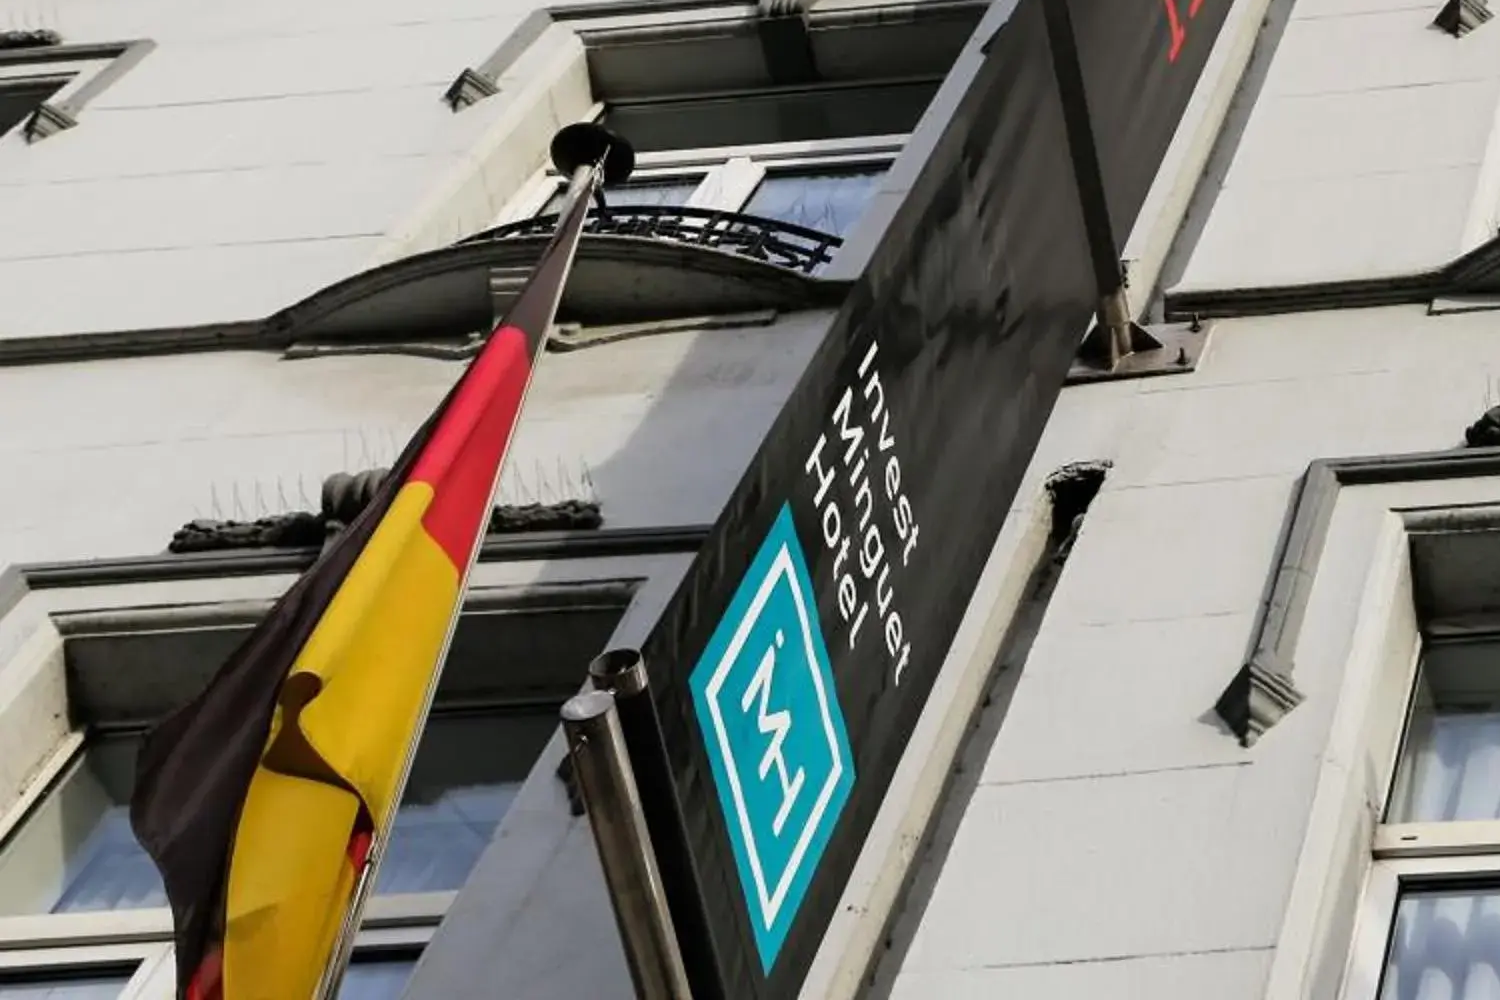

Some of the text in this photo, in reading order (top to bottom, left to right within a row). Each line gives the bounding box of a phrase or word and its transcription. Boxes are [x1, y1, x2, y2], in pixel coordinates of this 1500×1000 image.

[805, 432, 864, 649] Hotel
[832, 386, 912, 686] Minguet
[857, 340, 920, 567] Invest
